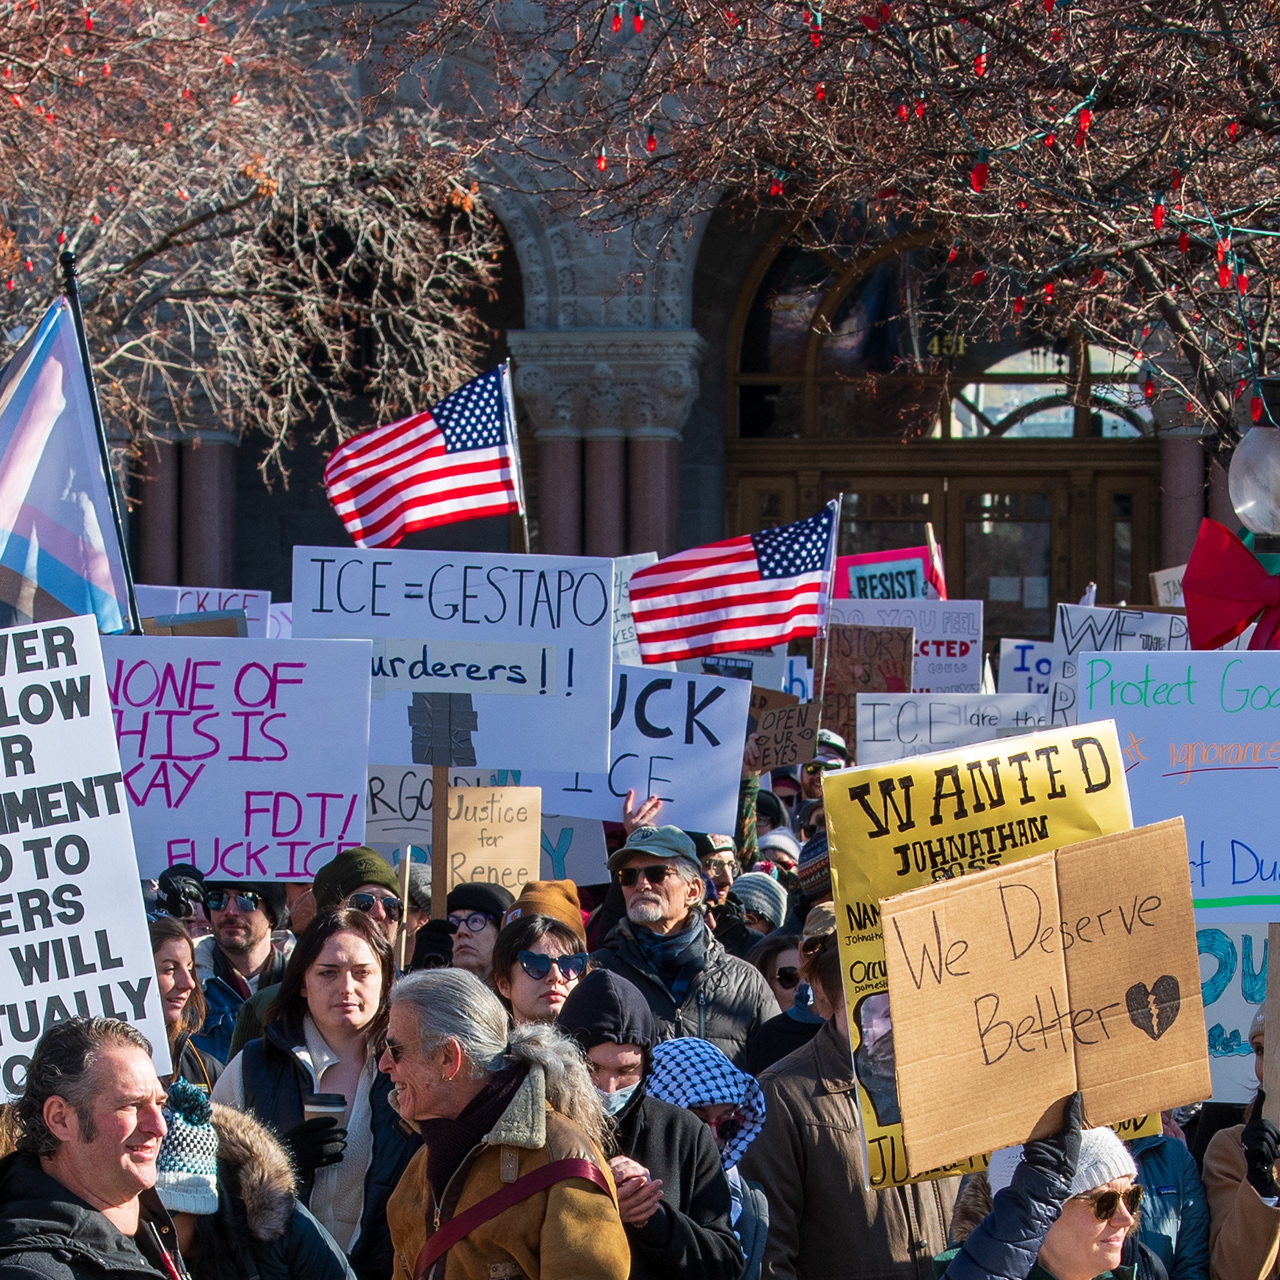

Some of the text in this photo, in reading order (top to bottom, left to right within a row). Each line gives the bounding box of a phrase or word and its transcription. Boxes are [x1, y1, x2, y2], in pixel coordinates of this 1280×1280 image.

[855, 569, 917, 600] RESIST
[942, 610, 980, 636] FEEL
[233, 660, 307, 709] OF
[371, 644, 528, 685] urderers
[1085, 658, 1197, 710] Protect
[227, 710, 289, 762] IS
[762, 706, 809, 731] OPEN
[774, 731, 794, 745] UR
[969, 712, 999, 727] are
[761, 743, 798, 767] EYES
[848, 736, 1112, 839] WANTED
[244, 791, 359, 842] FDT!
[447, 793, 529, 824] Justice
[22, 833, 90, 880] TO
[166, 837, 270, 878] FUCK
[477, 828, 504, 848] for
[892, 814, 1050, 877] JOHNATHAN
[450, 852, 530, 890] Renee
[892, 881, 1163, 990] We Deserve
[8, 928, 124, 988] WILL
[972, 986, 1123, 1067] Better
